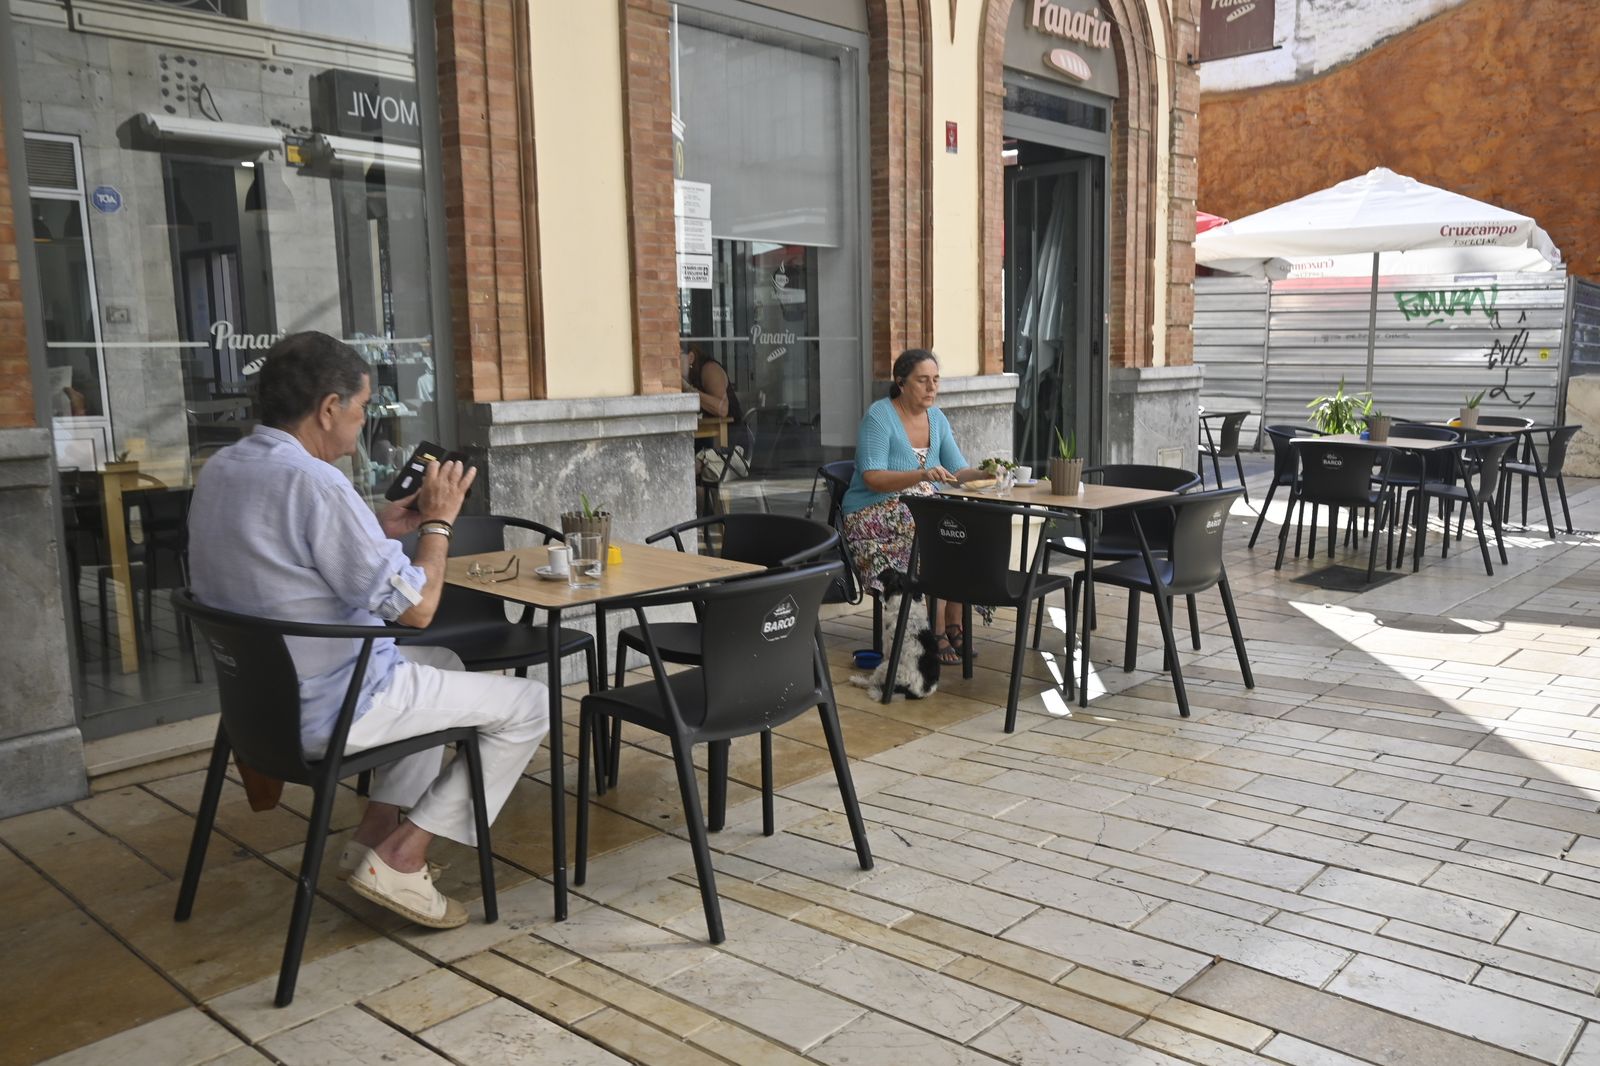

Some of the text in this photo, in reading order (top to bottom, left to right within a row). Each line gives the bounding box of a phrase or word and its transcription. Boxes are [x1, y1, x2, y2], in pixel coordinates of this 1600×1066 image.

[1032, 0, 1111, 48] Panaria
[1440, 224, 1518, 237] Cruzcampo
[750, 324, 795, 344] Panaria
[940, 528, 966, 538] BARCO
[763, 616, 796, 633] BARCO
